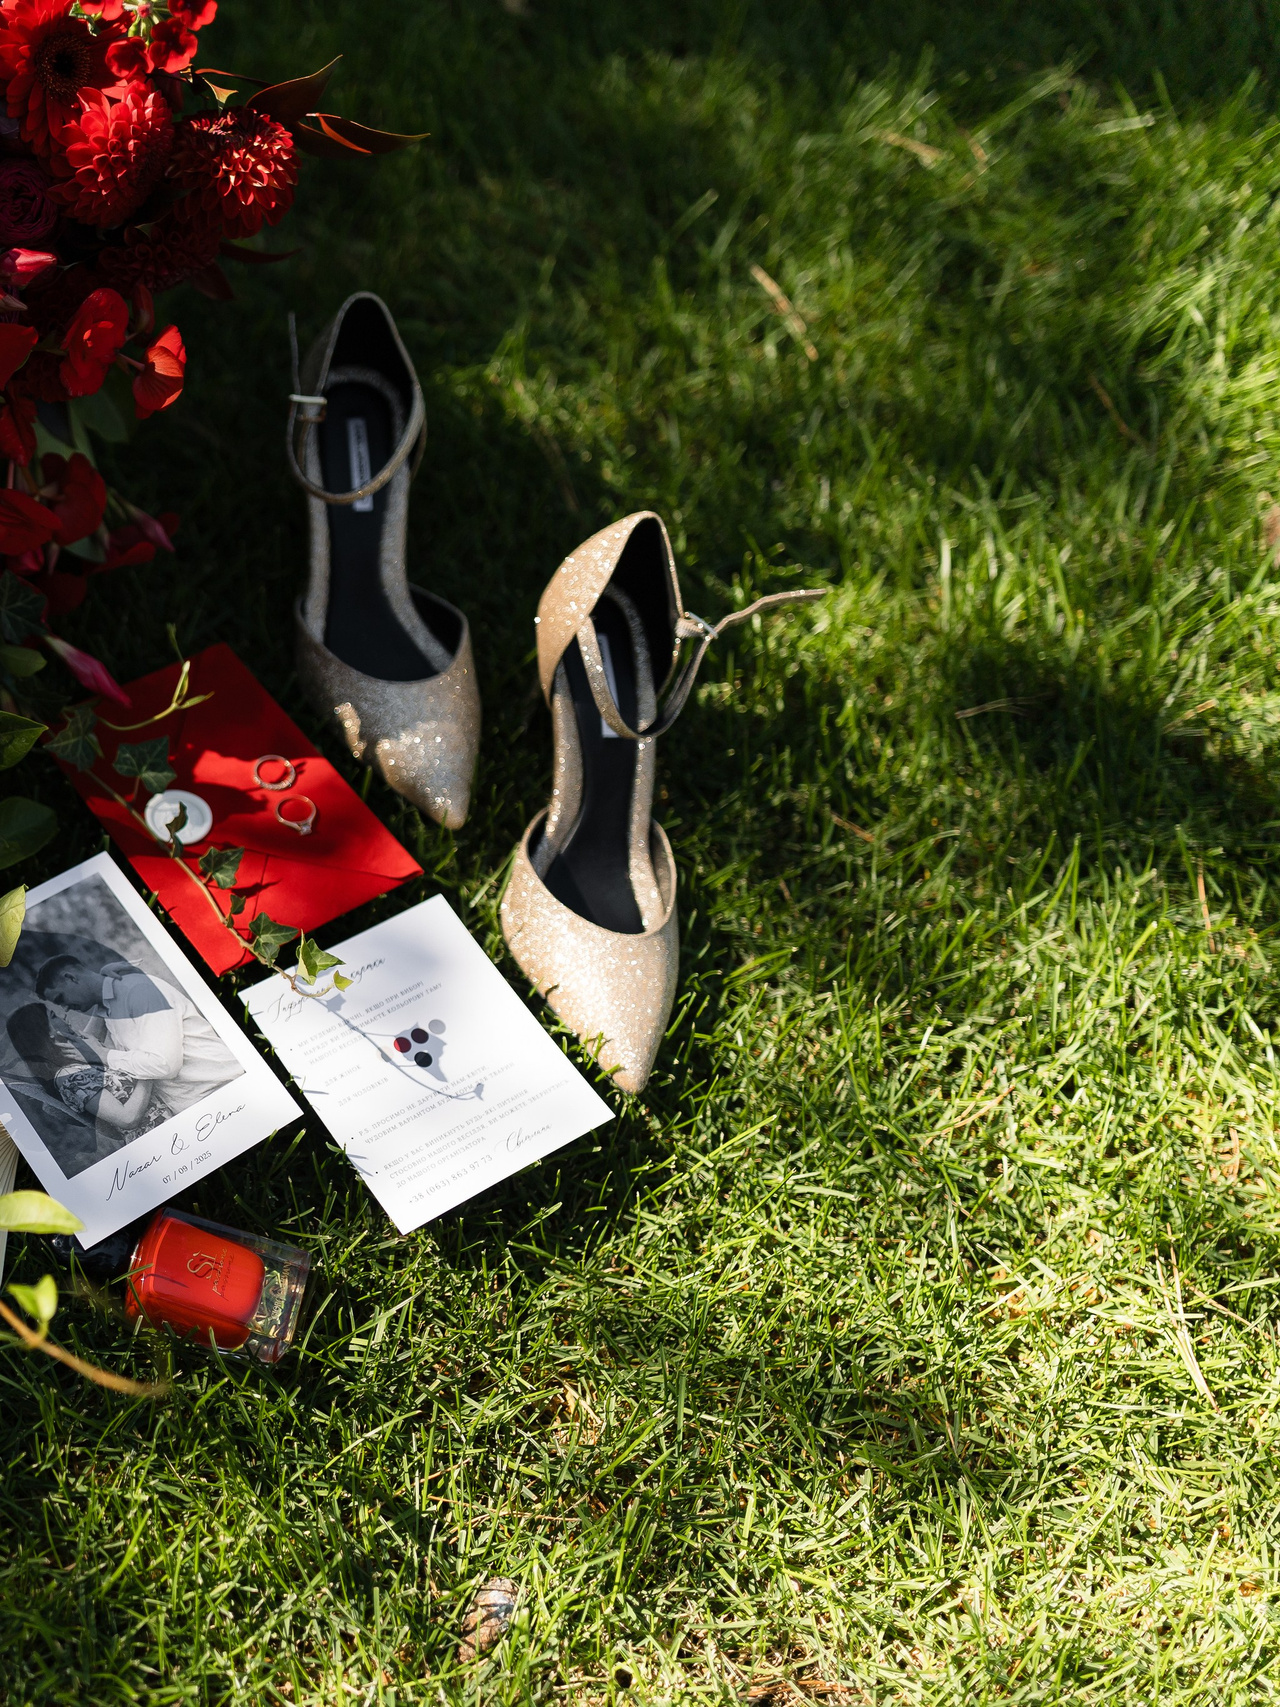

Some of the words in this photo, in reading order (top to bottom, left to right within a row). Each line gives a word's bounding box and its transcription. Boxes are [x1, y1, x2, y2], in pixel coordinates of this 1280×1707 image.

[363, 1000, 385, 1014] ЯКЩО
[384, 992, 400, 1004] ПРИ
[398, 980, 424, 996] ВИБОРІ
[386, 990, 426, 1014] КОЛЬОРОВУ
[424, 981, 444, 994] ГАМУ
[364, 1123, 398, 1145] ЧУДОВИМ
[397, 1102, 437, 1127] ВАРІАНТОМ
[370, 1107, 406, 1130] ПРОСИМО
[405, 1102, 417, 1111] НЕ
[449, 1075, 466, 1087] НАМ
[382, 1155, 404, 1171] ЯКЩО
[409, 1144, 425, 1156] ВАС
[423, 1122, 465, 1148] ВИНИКНУТЬ
[464, 1105, 497, 1126] БУДЬ-ЯКІ
[496, 1087, 529, 1109] ПИТАННЯ
[106, 1154, 162, 1202] Nazar
[170, 1133, 190, 1156] &
[195, 1104, 246, 1142] Elena
[162, 1174, 172, 1185] 07
[178, 1165, 188, 1176] 09
[195, 1150, 213, 1166] 2025
[388, 1155, 427, 1180] СТОСОВНО
[426, 1139, 457, 1159] НАШОГО
[487, 1116, 498, 1125] ВИ
[394, 1178, 407, 1188] ДО
[406, 1162, 437, 1182] НАШОГО
[435, 1134, 486, 1166] ОРГАНІЗАТОРА
[406, 1191, 425, 1206] +38
[424, 1177, 451, 1196] (063)
[449, 1167, 469, 1181] 863
[467, 1160, 481, 1171] 97
[479, 1153, 493, 1165] 73
